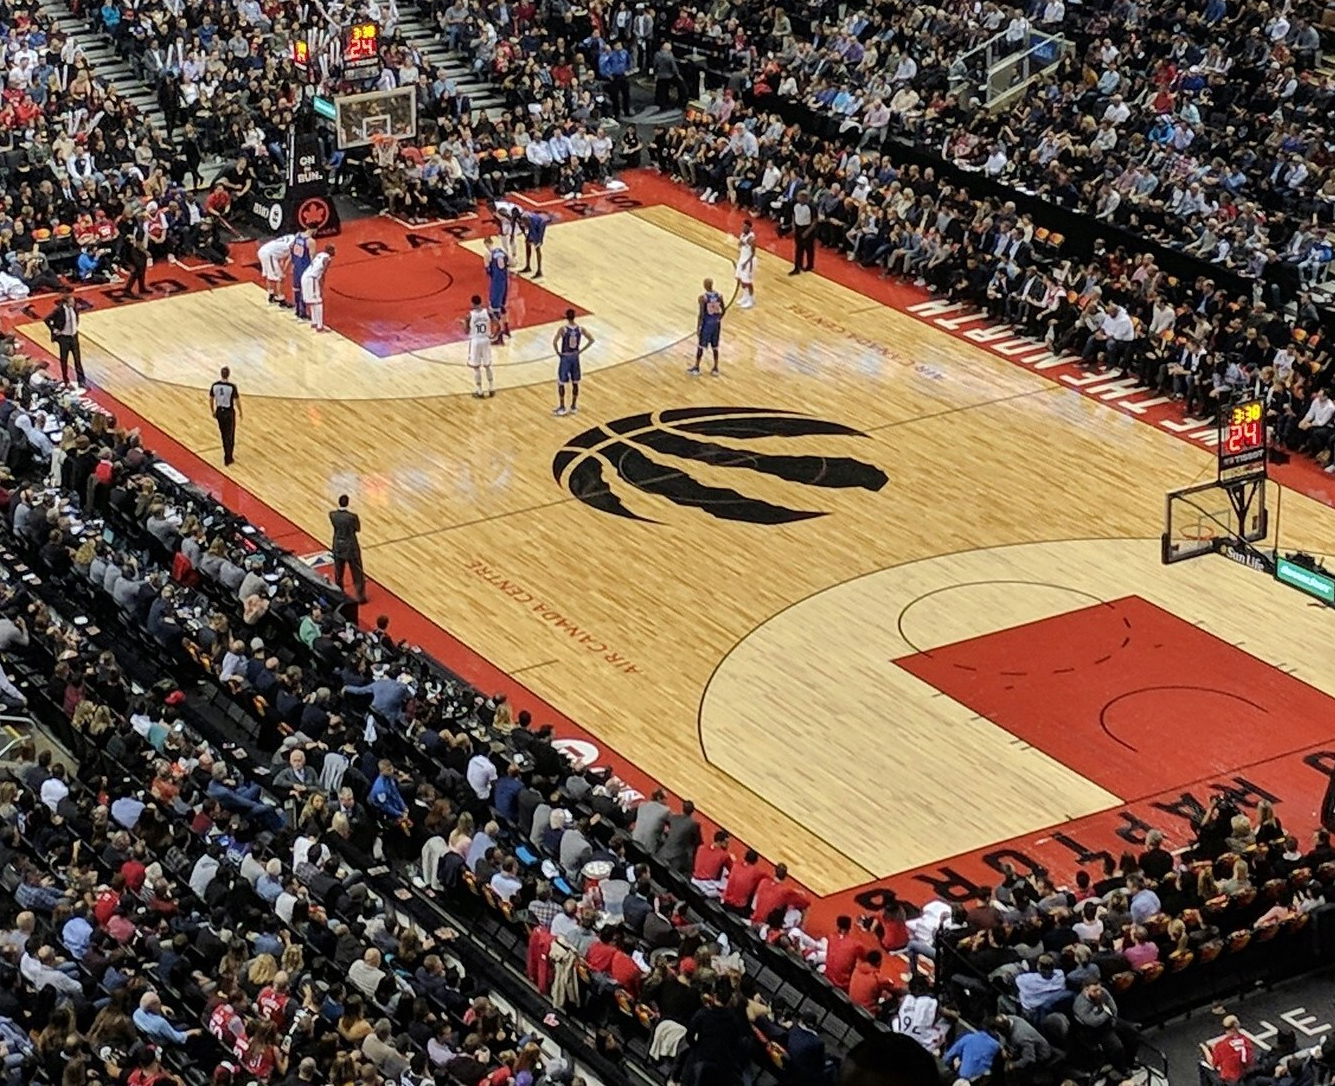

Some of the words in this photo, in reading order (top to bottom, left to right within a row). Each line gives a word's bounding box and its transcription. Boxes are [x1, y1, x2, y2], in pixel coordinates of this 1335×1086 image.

[299, 155, 315, 166] ON
[475, 323, 486, 334] 10
[1228, 422, 1257, 452] 24
[466, 561, 533, 604] CENTRE
[531, 602, 606, 653] CANADA
[607, 652, 644, 674] AIR
[1228, 1039, 1247, 1064] 7
